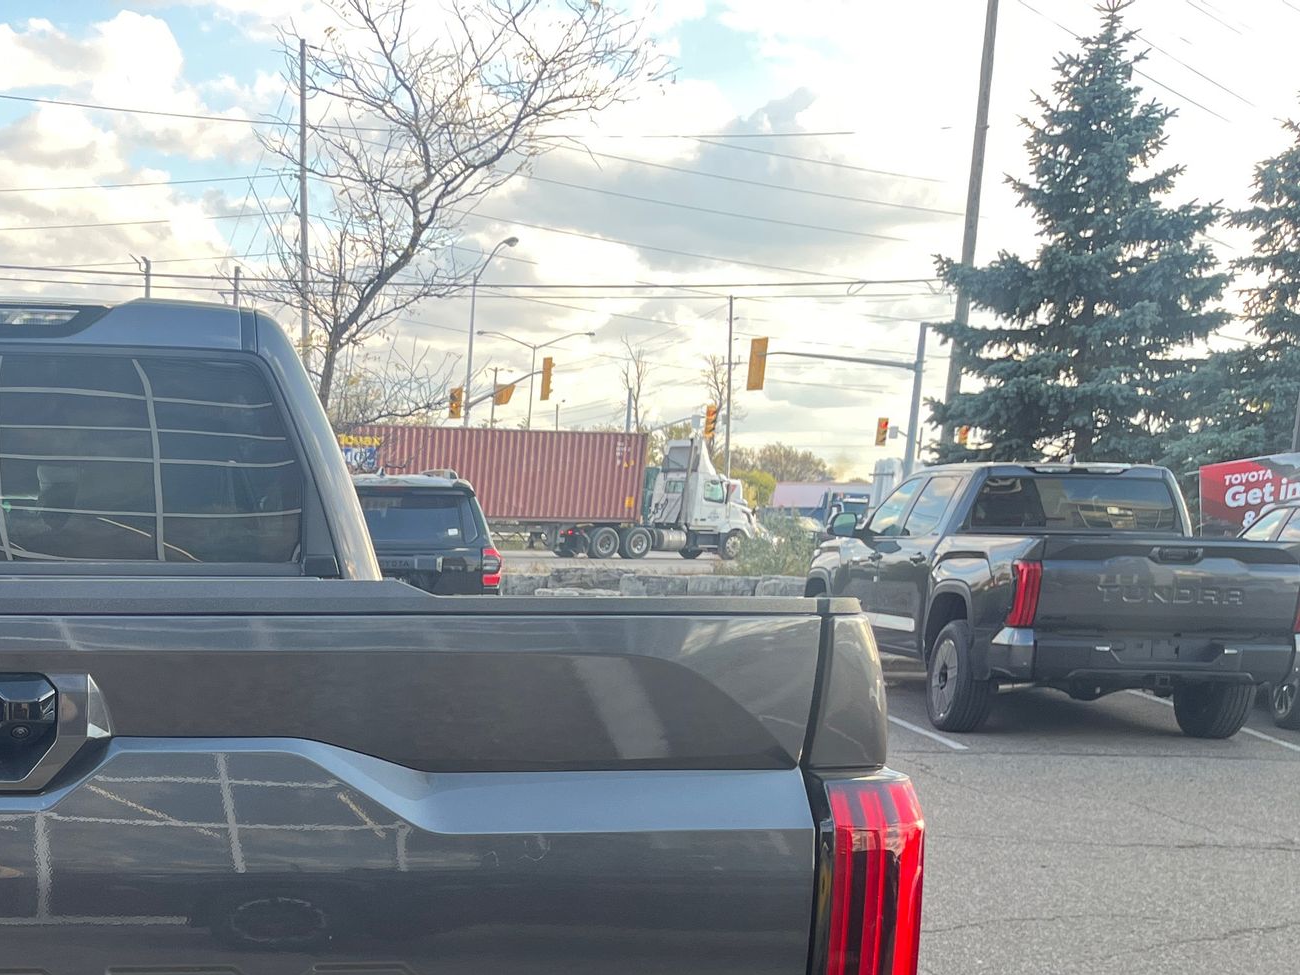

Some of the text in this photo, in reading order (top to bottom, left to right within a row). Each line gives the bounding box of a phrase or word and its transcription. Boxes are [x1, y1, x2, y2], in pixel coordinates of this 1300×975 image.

[1224, 469, 1273, 486] TOYOTA
[1225, 482, 1274, 508] Get
[1097, 584, 1244, 604] TUNDRA
